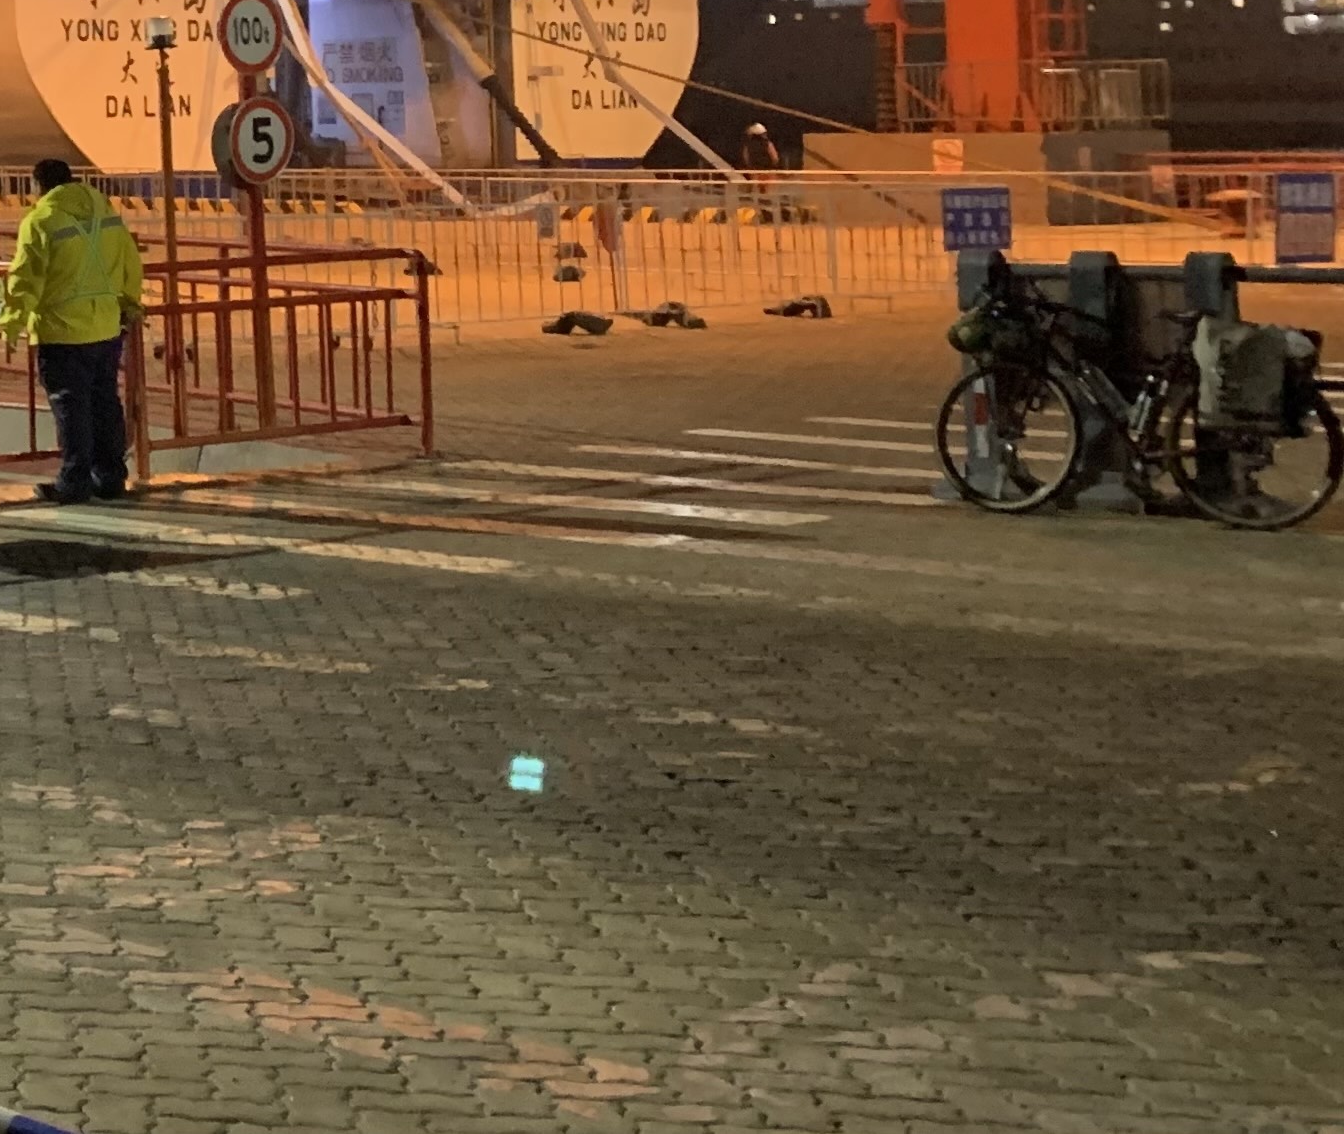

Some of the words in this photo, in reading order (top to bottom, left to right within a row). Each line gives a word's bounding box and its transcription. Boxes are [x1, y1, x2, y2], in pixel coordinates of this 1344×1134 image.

[60, 18, 119, 42] YONG
[187, 19, 214, 42] DA
[233, 17, 270, 46] 100t
[537, 21, 582, 42] YONG
[601, 21, 627, 42] ING
[635, 21, 667, 42] DAO
[106, 95, 133, 118] DA
[144, 94, 191, 117] LAN
[571, 89, 593, 110] DA
[252, 116, 274, 164] 5
